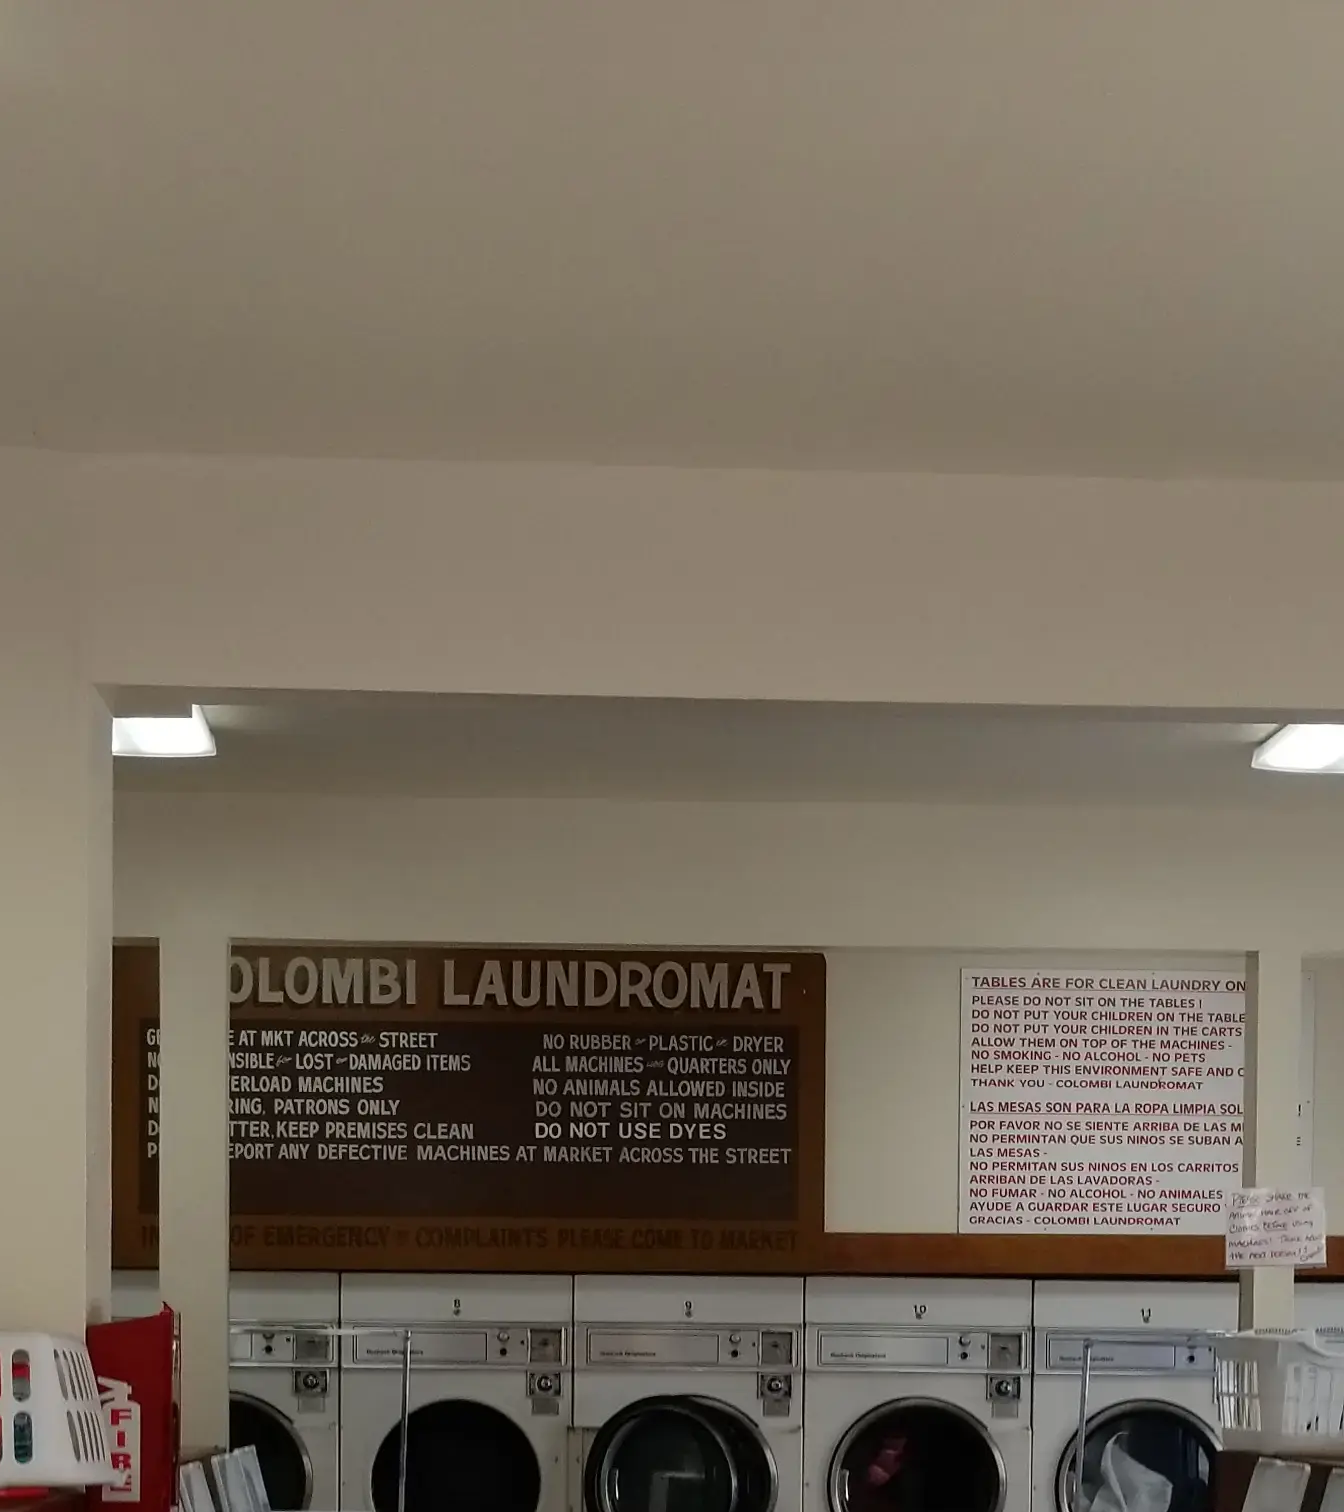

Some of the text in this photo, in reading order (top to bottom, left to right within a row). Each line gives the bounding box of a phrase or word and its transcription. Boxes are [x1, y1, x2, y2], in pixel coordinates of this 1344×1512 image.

[229, 956, 792, 1010] OLOMBI LAUNDROMAT
[971, 976, 1221, 992] TABLES ARE FOR CLEAN LAUNDRY
[971, 995, 1195, 1009] PLEASE DO NOT SIT ON THE TABLES
[971, 1009, 1247, 1024] DO NOT PUT YOUR CHILDREN ON THE TABLE
[238, 1029, 258, 1047] AT
[261, 1029, 295, 1047] MKT
[297, 1030, 359, 1048] ACROSS
[378, 1031, 439, 1049] STREET
[543, 1033, 784, 1053] NO RUBBER PLASTIC DRYER
[971, 1036, 1225, 1051] ALLOW THEM ON TOP OF THE MACHINES
[295, 1052, 334, 1071] LOST
[349, 1053, 422, 1071] DAMAGED
[426, 1054, 471, 1072] ITEMS
[971, 1049, 1206, 1063] NO SMOKING NO ALCOHOL NO PETS
[531, 1055, 792, 1075] ALL MACHINES QUARTERS ONLY
[971, 1063, 1003, 1074] HELP
[1006, 1063, 1039, 1075] KEEP
[1042, 1064, 1071, 1075] THIS
[1074, 1064, 1168, 1077] ENVIRONMENT
[1171, 1066, 1203, 1077] SAFE
[1205, 1067, 1234, 1077] AND
[230, 1075, 384, 1094] ERLOAD MACHINES
[532, 1078, 785, 1098] NO ANIMALS ALLOWED INSIDE
[970, 1078, 1204, 1090] THANK YOU COLOMBI LAUNDROMAT
[273, 1098, 350, 1115] PATRONS
[357, 1098, 401, 1116] ONLY
[535, 1100, 787, 1121] DO NOT SIT ON MACHINES
[969, 1101, 995, 1113] LAS
[997, 1101, 1042, 1113] MESAS
[1045, 1101, 1072, 1113] SON
[1075, 1102, 1111, 1114] PARA
[1114, 1102, 1131, 1114] LA
[1134, 1103, 1169, 1115] ROPA
[1172, 1103, 1217, 1115] LIMPIA
[325, 1121, 408, 1140] PREMISES
[413, 1122, 474, 1140] CLEAN
[535, 1121, 727, 1140] DO NOT USE DYES
[969, 1119, 996, 1131] POR
[999, 1120, 1041, 1131] FAVOR
[1044, 1120, 1063, 1131] NO
[1065, 1121, 1081, 1131] SE
[1085, 1121, 1129, 1132] SIENTE
[1132, 1121, 1180, 1132] ARRIBA
[1183, 1121, 1200, 1133] DE
[1203, 1122, 1227, 1133] LAS
[969, 1133, 989, 1144] NO
[991, 1133, 1067, 1145] PERMINTAN
[1070, 1134, 1096, 1146] QUE
[1099, 1134, 1123, 1145] SUS
[1127, 1135, 1166, 1145] NINOS
[1169, 1135, 1184, 1145] SE
[1187, 1135, 1231, 1146] SUBAN
[229, 1142, 793, 1165] EPORT ANY DEFECTIVE MACHINES AT MARKET ACROSS THE STREET
[969, 1187, 988, 1198] NO
[991, 1187, 1037, 1199] FUMAR
[1047, 1188, 1067, 1199] NO
[1069, 1188, 1127, 1199] ALCOHOL
[1137, 1189, 1156, 1199] NO
[1158, 1189, 1223, 1200] ANIMALES
[969, 1201, 1221, 1213] AYUDE A GUARDAR ESTE LUGAR SEGURO
[969, 1215, 1181, 1226] GRACIAS COLOMBI LAUNDROMAT
